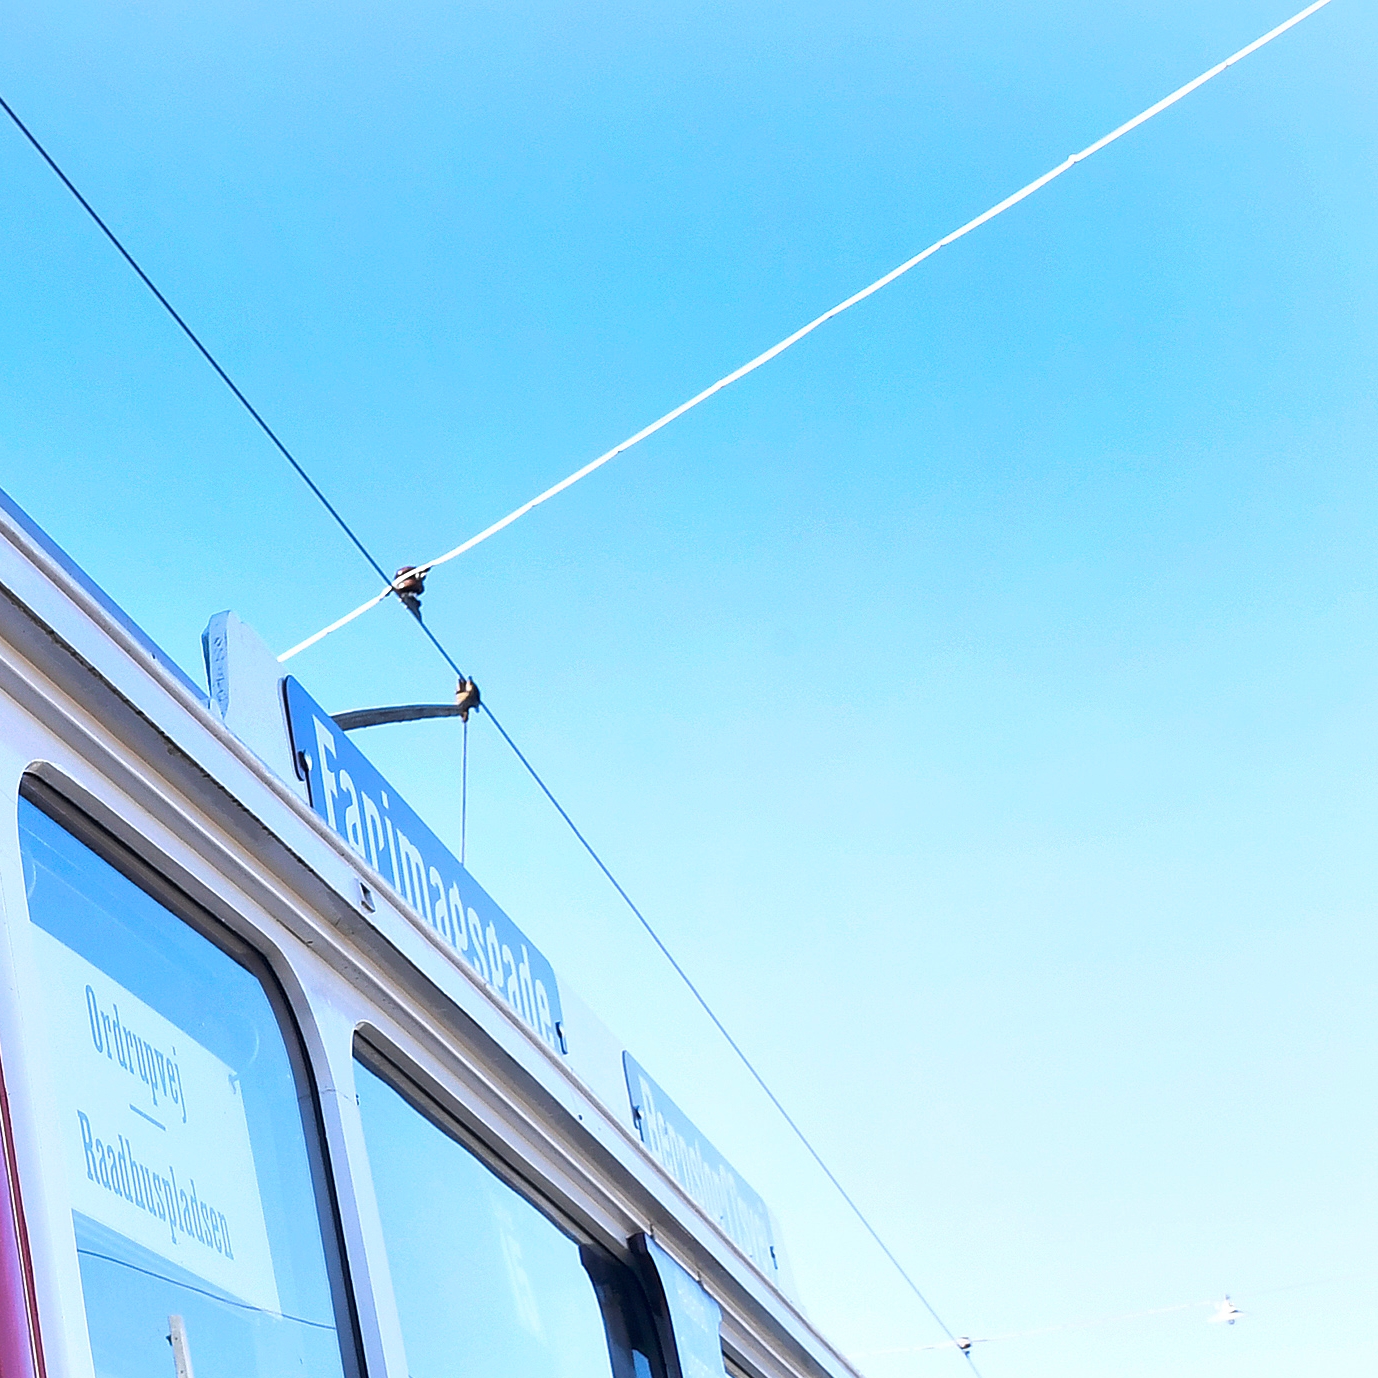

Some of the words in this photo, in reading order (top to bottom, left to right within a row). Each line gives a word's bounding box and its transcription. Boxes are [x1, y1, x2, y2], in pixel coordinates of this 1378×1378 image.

[312, 714, 555, 1047] Farimagsgade
[85, 984, 187, 1124] Ordrupvej
[77, 1109, 234, 1260] Raadhuspladsen
